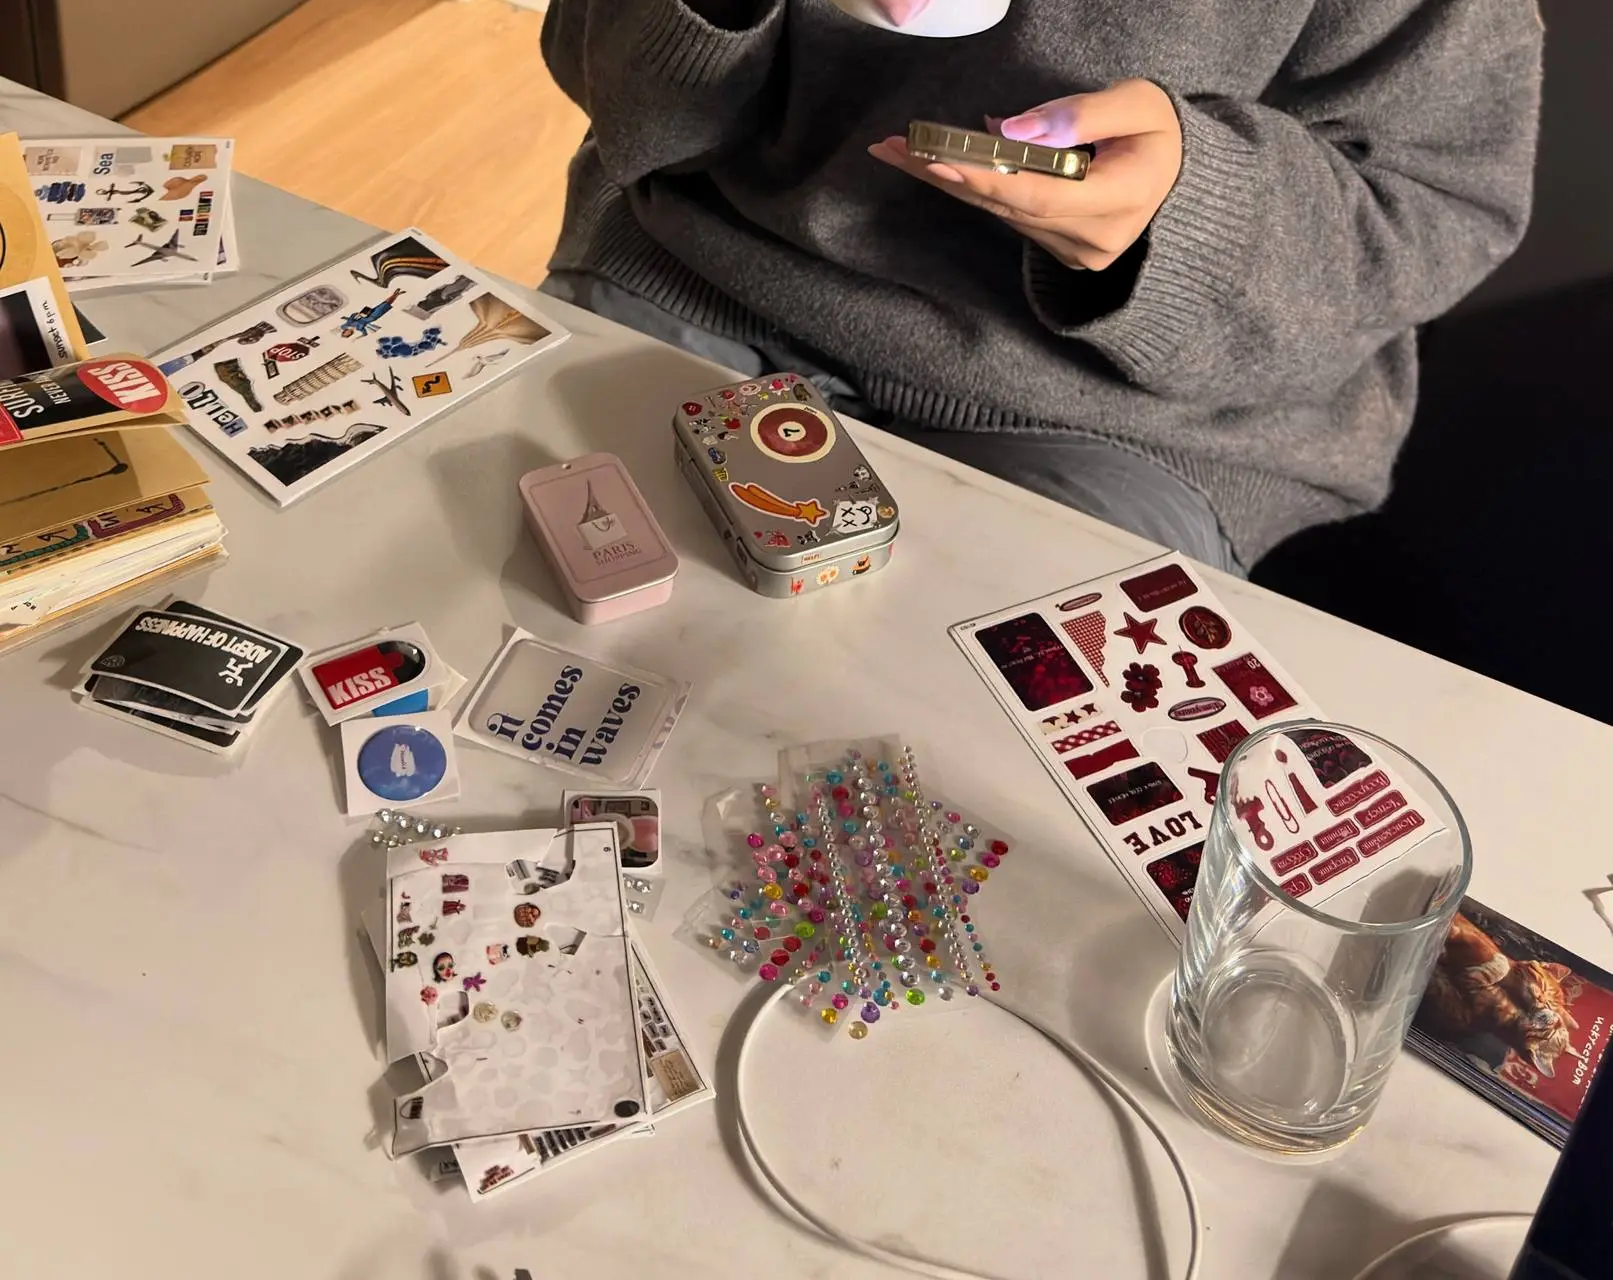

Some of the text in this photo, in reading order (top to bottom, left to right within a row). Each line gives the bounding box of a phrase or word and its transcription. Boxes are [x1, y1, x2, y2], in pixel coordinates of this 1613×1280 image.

[93, 152, 114, 175] Sea
[48, 328, 68, 359] sunset
[270, 345, 306, 362] STOP
[87, 362, 162, 404] KISS
[592, 542, 635, 560] PARIS
[136, 616, 272, 664] ADEPT OF HAPPINESS
[1247, 658, 1261, 669] 20
[327, 666, 392, 706] KISS
[521, 665, 583, 751] comes
[579, 683, 641, 765] waves
[486, 712, 525, 742] it
[546, 727, 587, 760] in
[1122, 810, 1203, 856] LOVE
